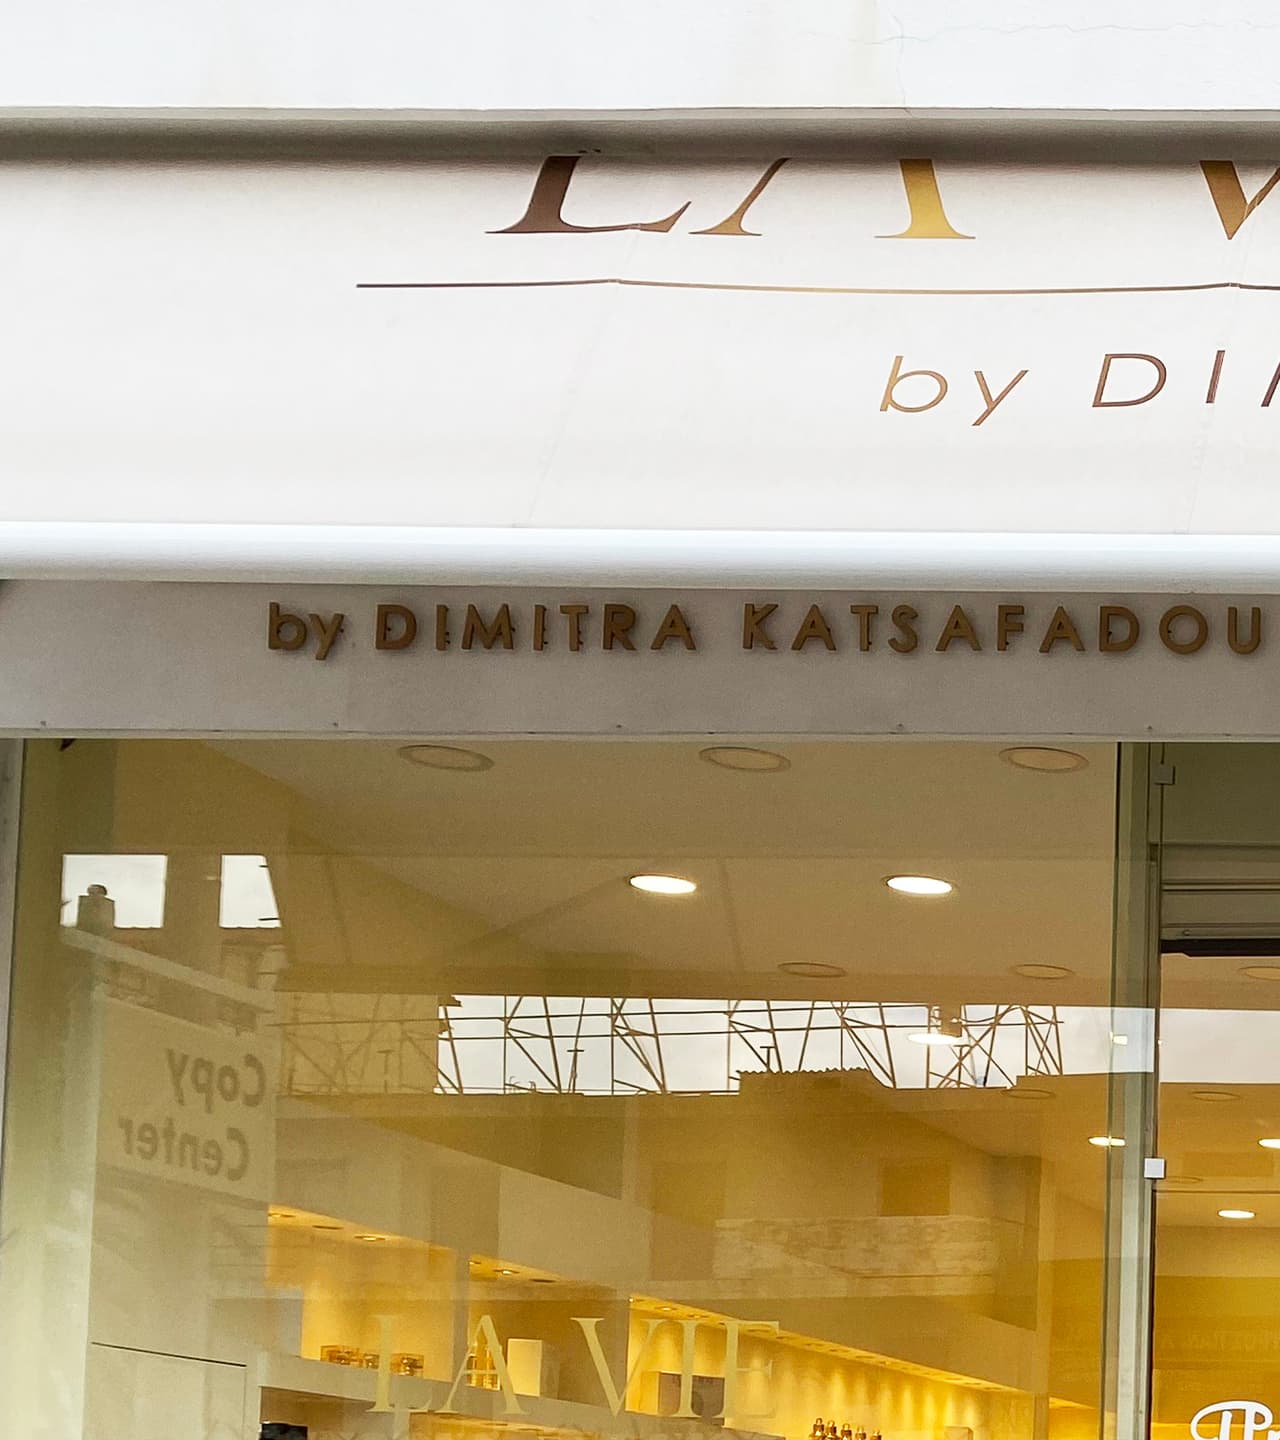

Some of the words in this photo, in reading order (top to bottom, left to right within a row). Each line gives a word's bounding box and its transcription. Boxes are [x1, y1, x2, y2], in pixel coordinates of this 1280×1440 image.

[878, 354, 1030, 427] by
[267, 601, 344, 661] by
[374, 602, 698, 653] DIMITRA
[740, 602, 1264, 656] KATSAFADOU
[365, 1314, 530, 1416] LA
[570, 1316, 780, 1421] VIE
